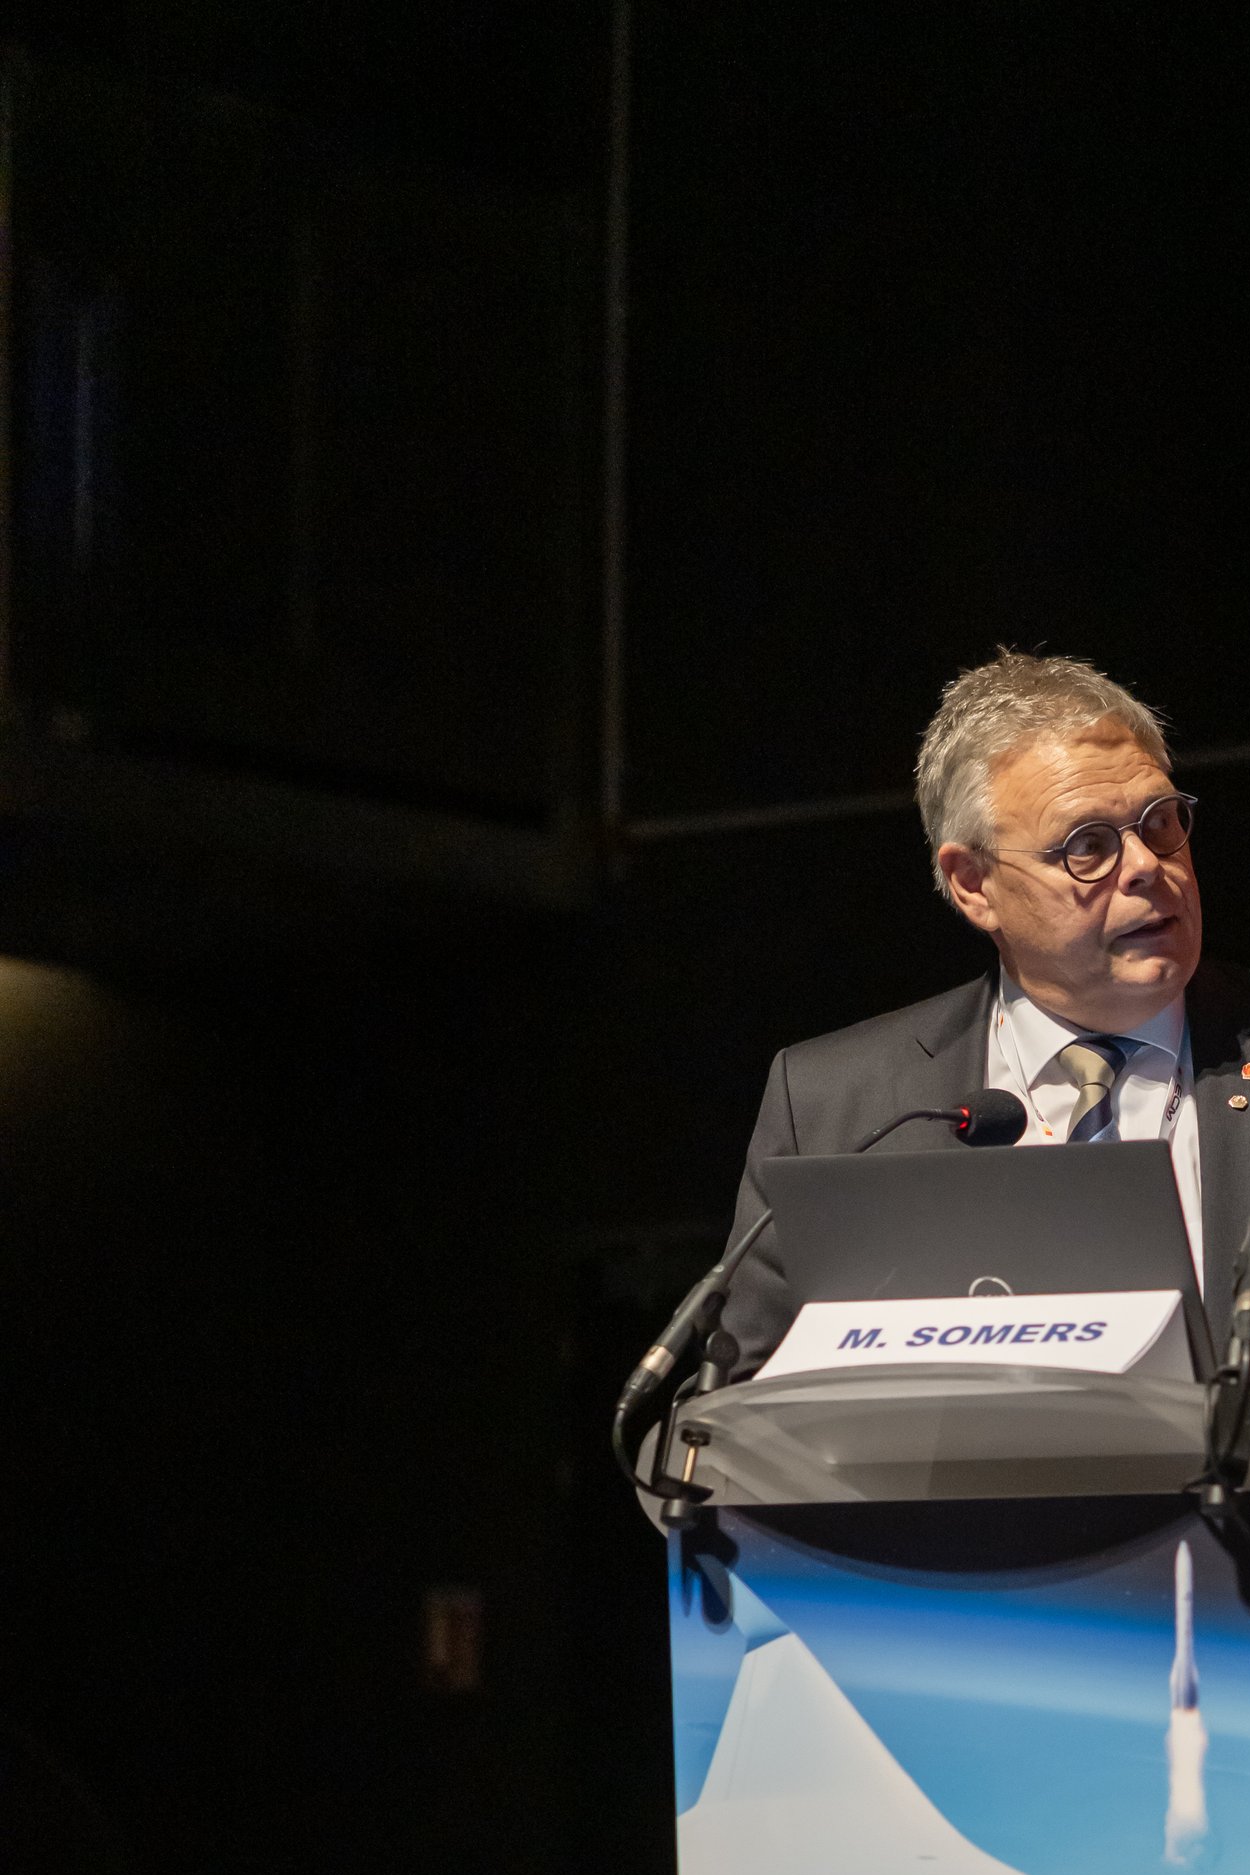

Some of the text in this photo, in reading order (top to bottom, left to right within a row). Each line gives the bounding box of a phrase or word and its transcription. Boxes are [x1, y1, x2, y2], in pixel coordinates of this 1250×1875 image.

[1166, 1083, 1182, 1121] ECM
[837, 1321, 1108, 1349] M. SOMERS
